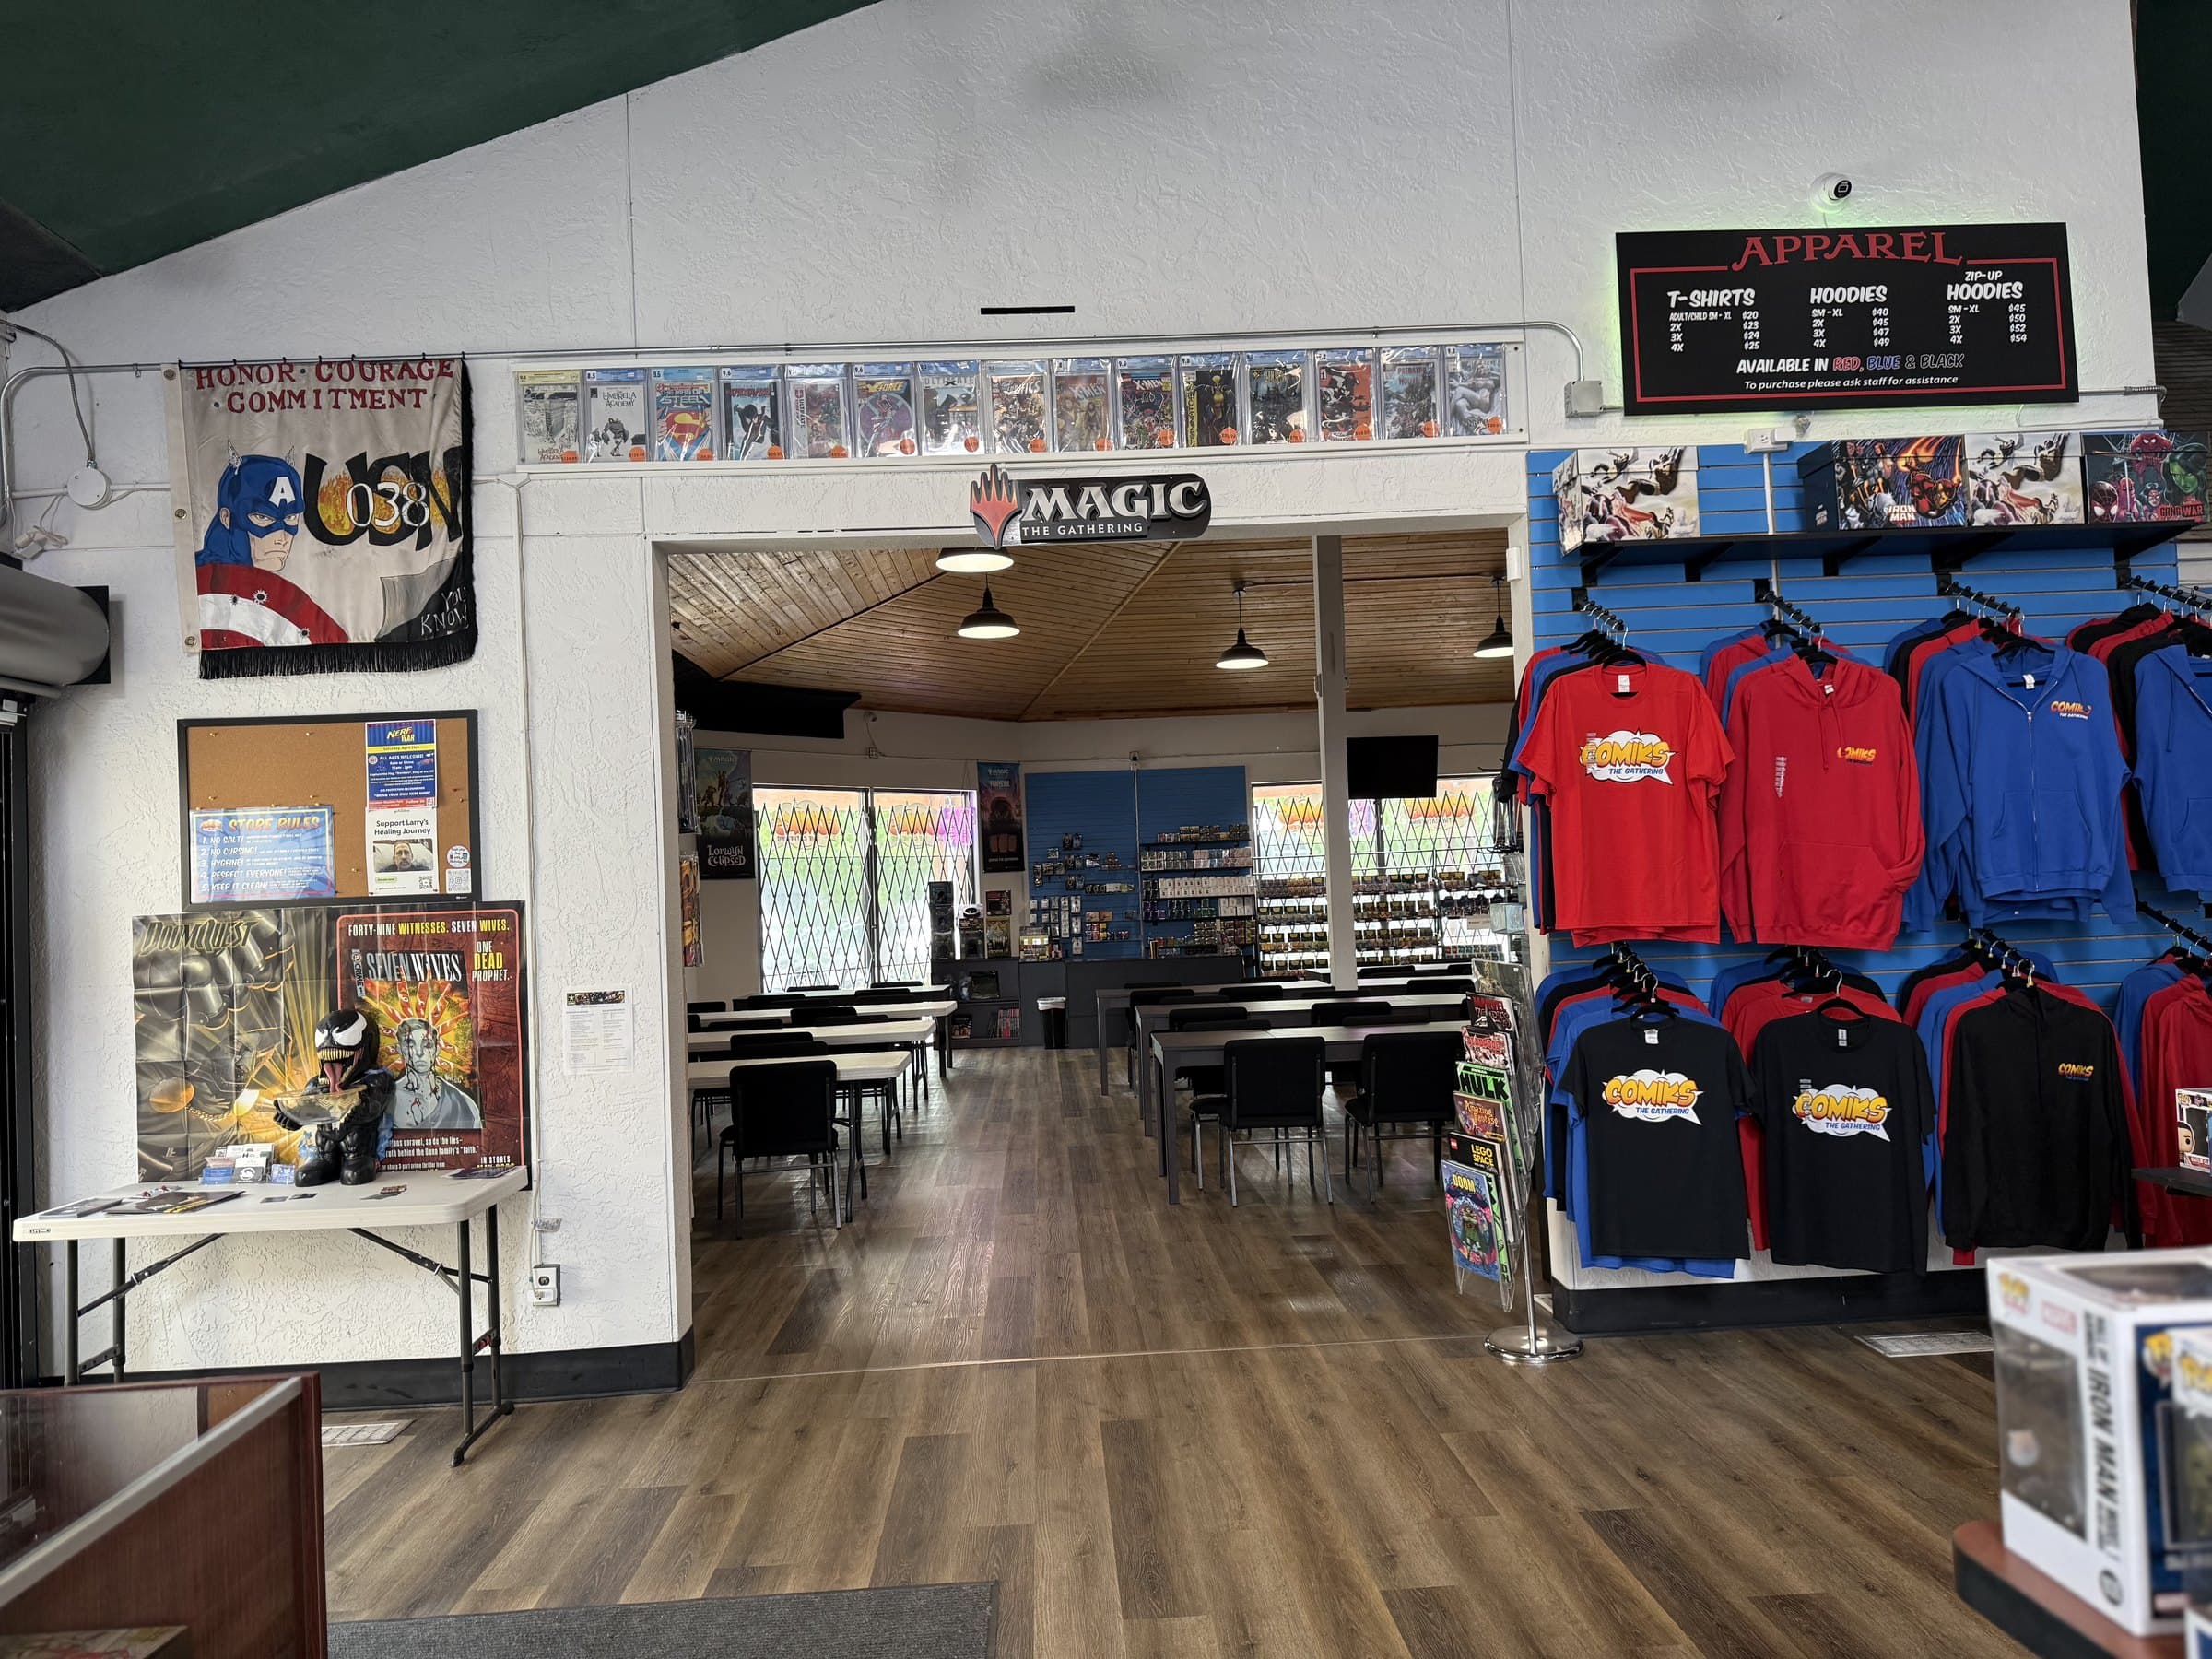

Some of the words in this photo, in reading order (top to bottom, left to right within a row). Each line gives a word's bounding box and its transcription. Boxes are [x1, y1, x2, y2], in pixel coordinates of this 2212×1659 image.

[1731, 231, 1963, 271] APPAREL
[1964, 271, 2003, 282] ZIP-UP
[1810, 285, 1888, 304] HOODIES
[1947, 281, 2024, 300] HOODIES
[1666, 288, 1756, 308] T-SHIRTS
[1872, 307, 1888, 317] $40
[2008, 303, 2026, 312] $45
[1669, 312, 1708, 322] ADULT/CHILD
[1724, 311, 1732, 320] XL
[1742, 311, 1759, 320] $20
[1812, 319, 1825, 327] 2X
[1872, 317, 1889, 326] $45
[1948, 315, 1961, 324] 2X
[2009, 313, 2026, 323] $50
[1670, 323, 1682, 332] 2X
[1743, 321, 1759, 330] $23
[1813, 329, 1825, 337] 3X
[1873, 327, 1889, 336] $47
[1949, 325, 1962, 334] 3X
[2009, 324, 2027, 333] $52
[1670, 333, 1683, 342] 3X
[1743, 331, 1760, 340] $24
[1813, 338, 1826, 347] 4X
[1874, 337, 1890, 347] $49
[1949, 335, 1963, 344] 4X
[2010, 334, 2028, 343] $54
[1670, 343, 1684, 352] 4X
[1744, 341, 1760, 350] $25
[1736, 358, 1810, 374] AVAILABLE
[1814, 358, 1830, 372] IN
[1832, 357, 1864, 372] RED,
[1866, 355, 1901, 370] BLUE
[1904, 355, 1916, 369] &
[1920, 353, 1965, 369] BLACK
[195, 362, 295, 390] HONOR
[315, 359, 454, 382] COURAGE
[1744, 381, 1756, 390] To
[1758, 380, 1806, 391] purchase
[1807, 378, 1841, 390] please
[1842, 377, 1861, 387] ask
[1863, 376, 1887, 387] staff
[1886, 376, 1903, 387] for
[1904, 375, 1959, 385] assistance
[227, 388, 428, 413] COMMITMENT
[346, 482, 430, 527] 038
[1020, 481, 1207, 524] MAGIC
[1888, 504, 1917, 513] IRON
[1889, 512, 1917, 522] MAN
[1022, 526, 1050, 537] THE
[1057, 522, 1143, 536] GATHERING
[386, 726, 413, 740] NERF
[1582, 741, 1670, 767] COMIKS
[229, 818, 273, 831] STORE
[276, 817, 320, 830] RULES
[376, 820, 405, 829] Support
[223, 847, 258, 855] CURSING!
[212, 870, 244, 878] RESPECT
[246, 868, 288, 877] EVERYONE!
[212, 883, 231, 891] KEEP
[348, 923, 395, 936] FORTY-NINE
[398, 922, 449, 935] WITNESSES.
[452, 920, 477, 933] SEVEN
[479, 919, 510, 932] WIVES.
[477, 940, 492, 953] ONE
[366, 952, 411, 981] SEVEN
[411, 952, 462, 982] WIVES
[474, 952, 503, 970] DEAD
[472, 969, 510, 982] PROPHET.
[2058, 1063, 2094, 1077] COMIKS
[1459, 1073, 1509, 1100] HULK
[1604, 1078, 1699, 1106] COMIKS
[1650, 1107, 1689, 1115] GATHERING
[1794, 1092, 1888, 1122] COMIKS
[1841, 1123, 1881, 1132] GATHERING
[1471, 1144, 1492, 1158] LEGO
[488, 1155, 511, 1164] STORES
[1472, 1154, 1494, 1167] SPACE
[1453, 1174, 1476, 1194] DOOM
[2087, 1366, 2115, 1435] IRON
[2091, 1436, 2118, 1506] MAN
